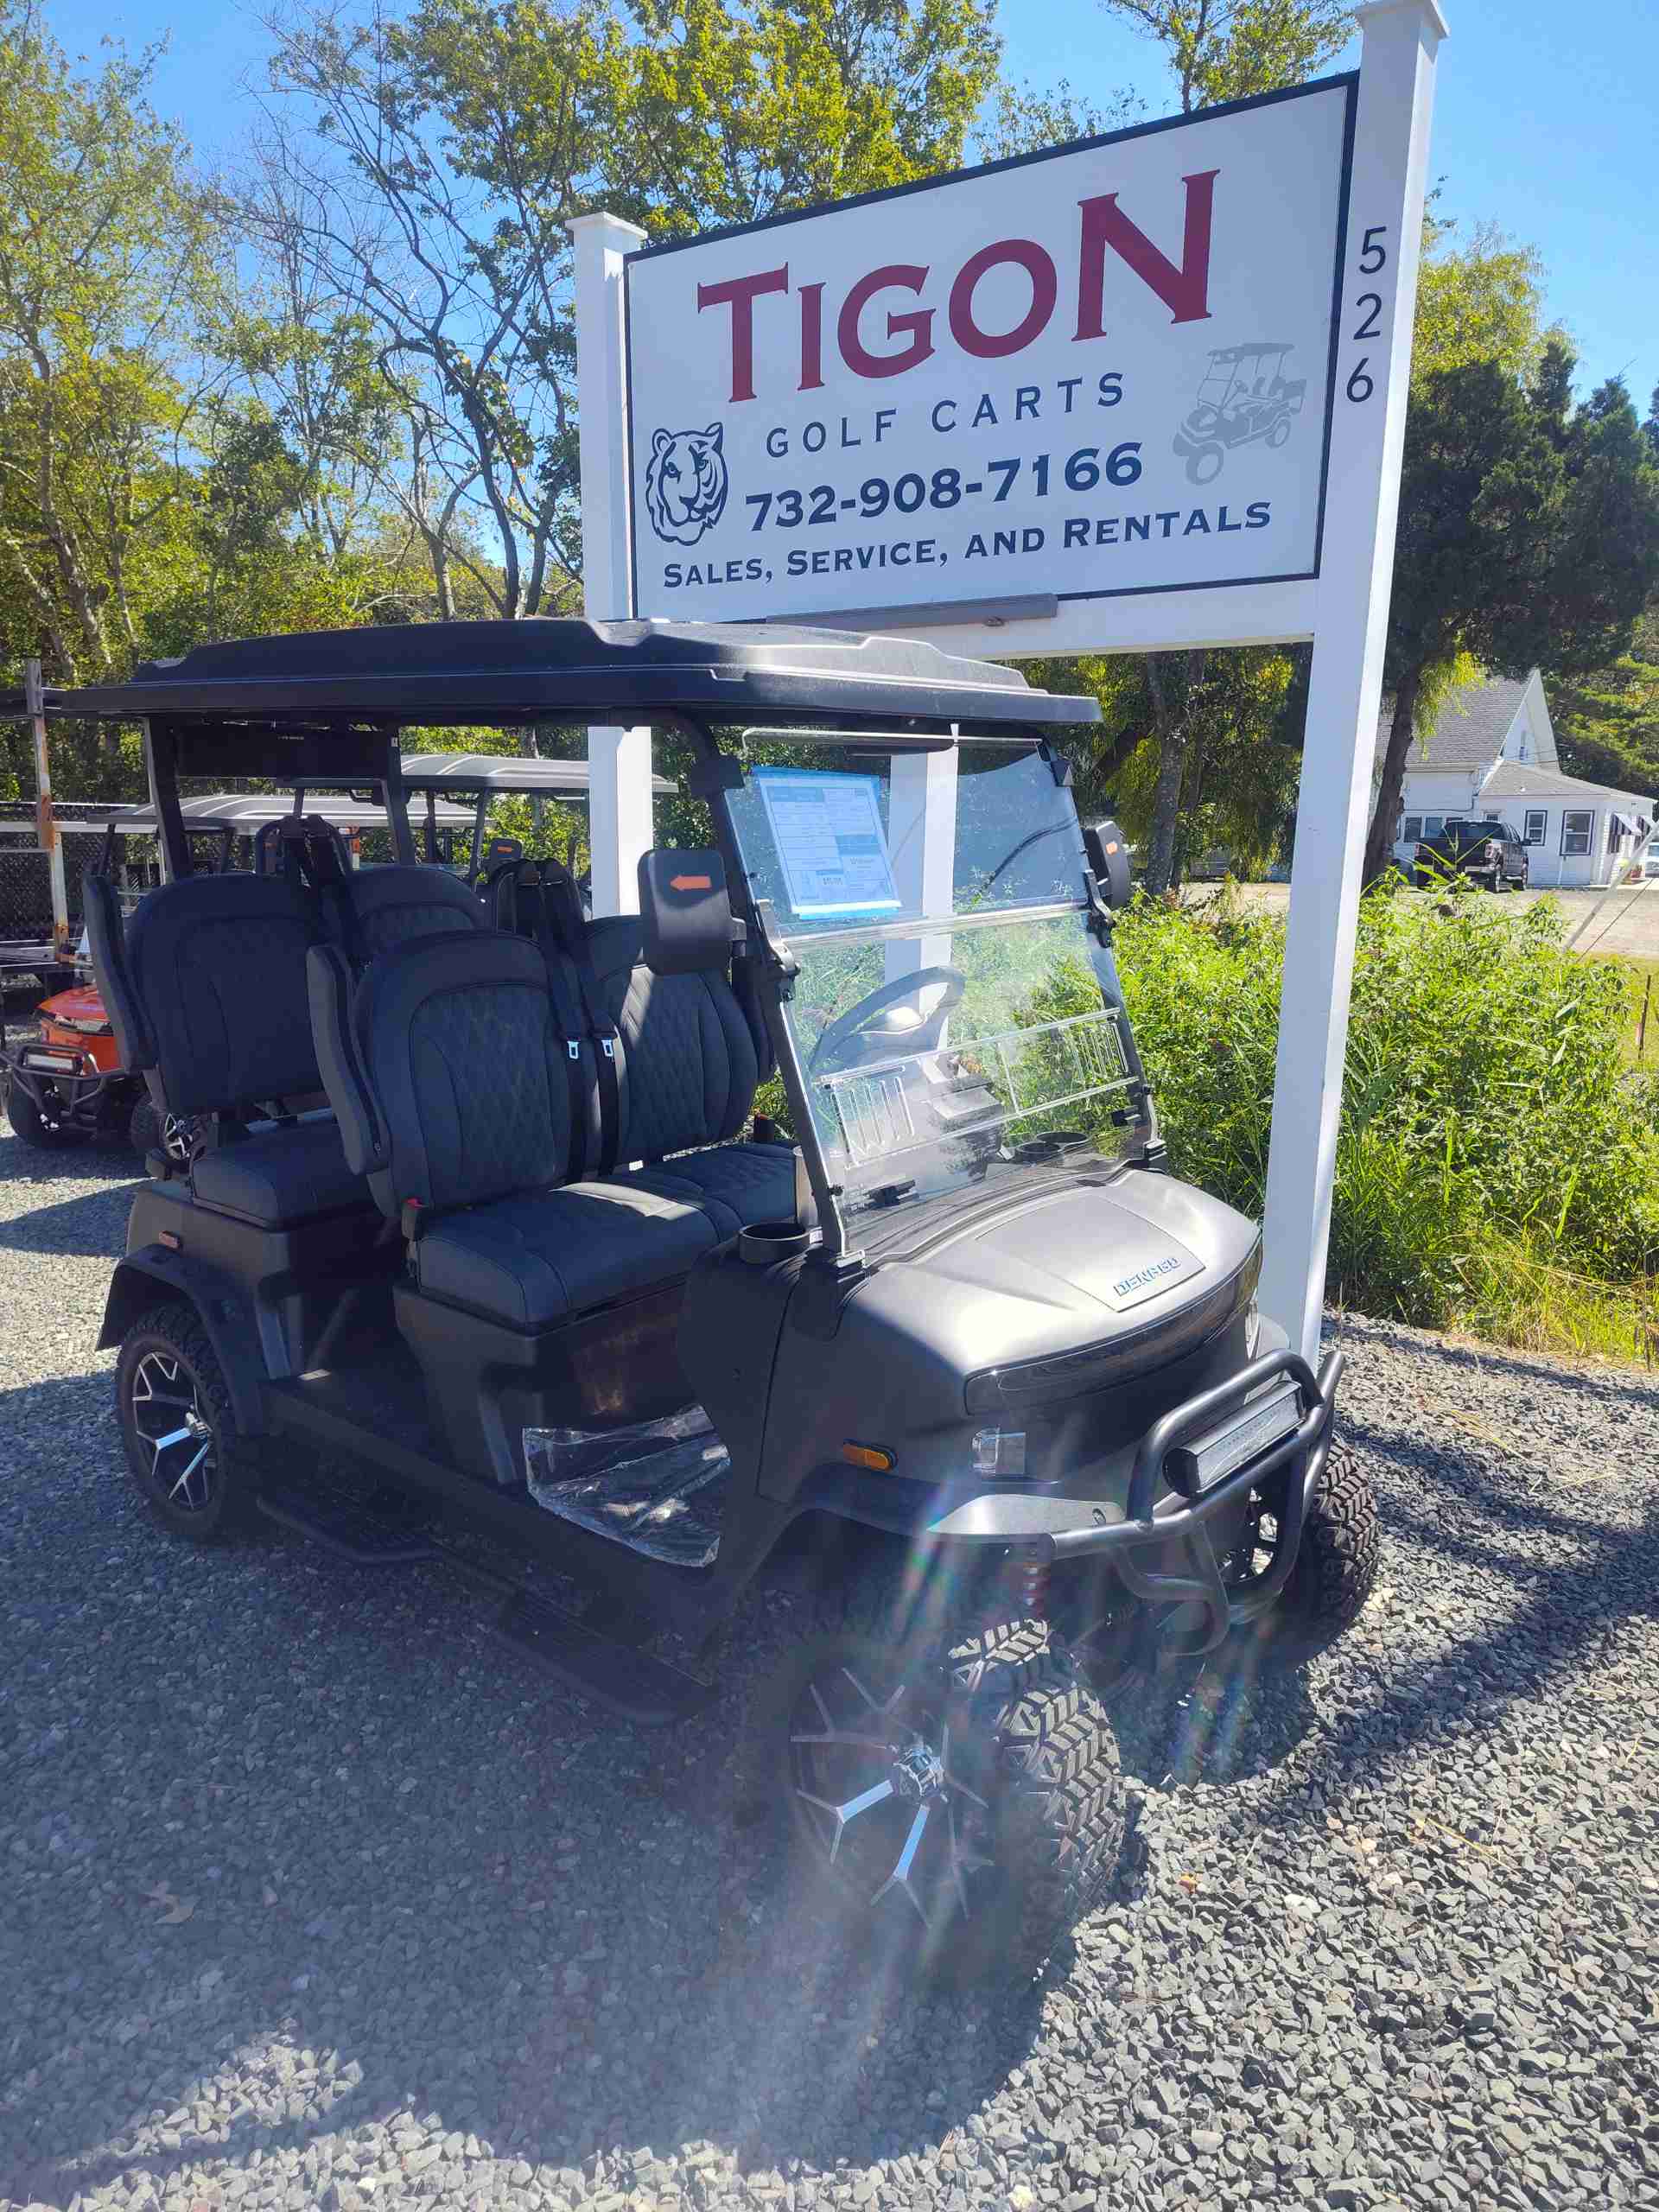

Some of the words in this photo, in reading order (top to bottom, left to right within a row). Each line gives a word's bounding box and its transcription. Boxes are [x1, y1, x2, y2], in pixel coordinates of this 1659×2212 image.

[697, 168, 1220, 404] TIGON
[766, 408, 896, 458] GOLF
[932, 372, 1124, 433] CARTS
[746, 442, 1143, 532] 732-908-7166
[664, 558, 773, 588] SALES,
[787, 538, 948, 576] SERVICE,
[965, 527, 1046, 559] AND
[1064, 501, 1271, 549] RENTALS
